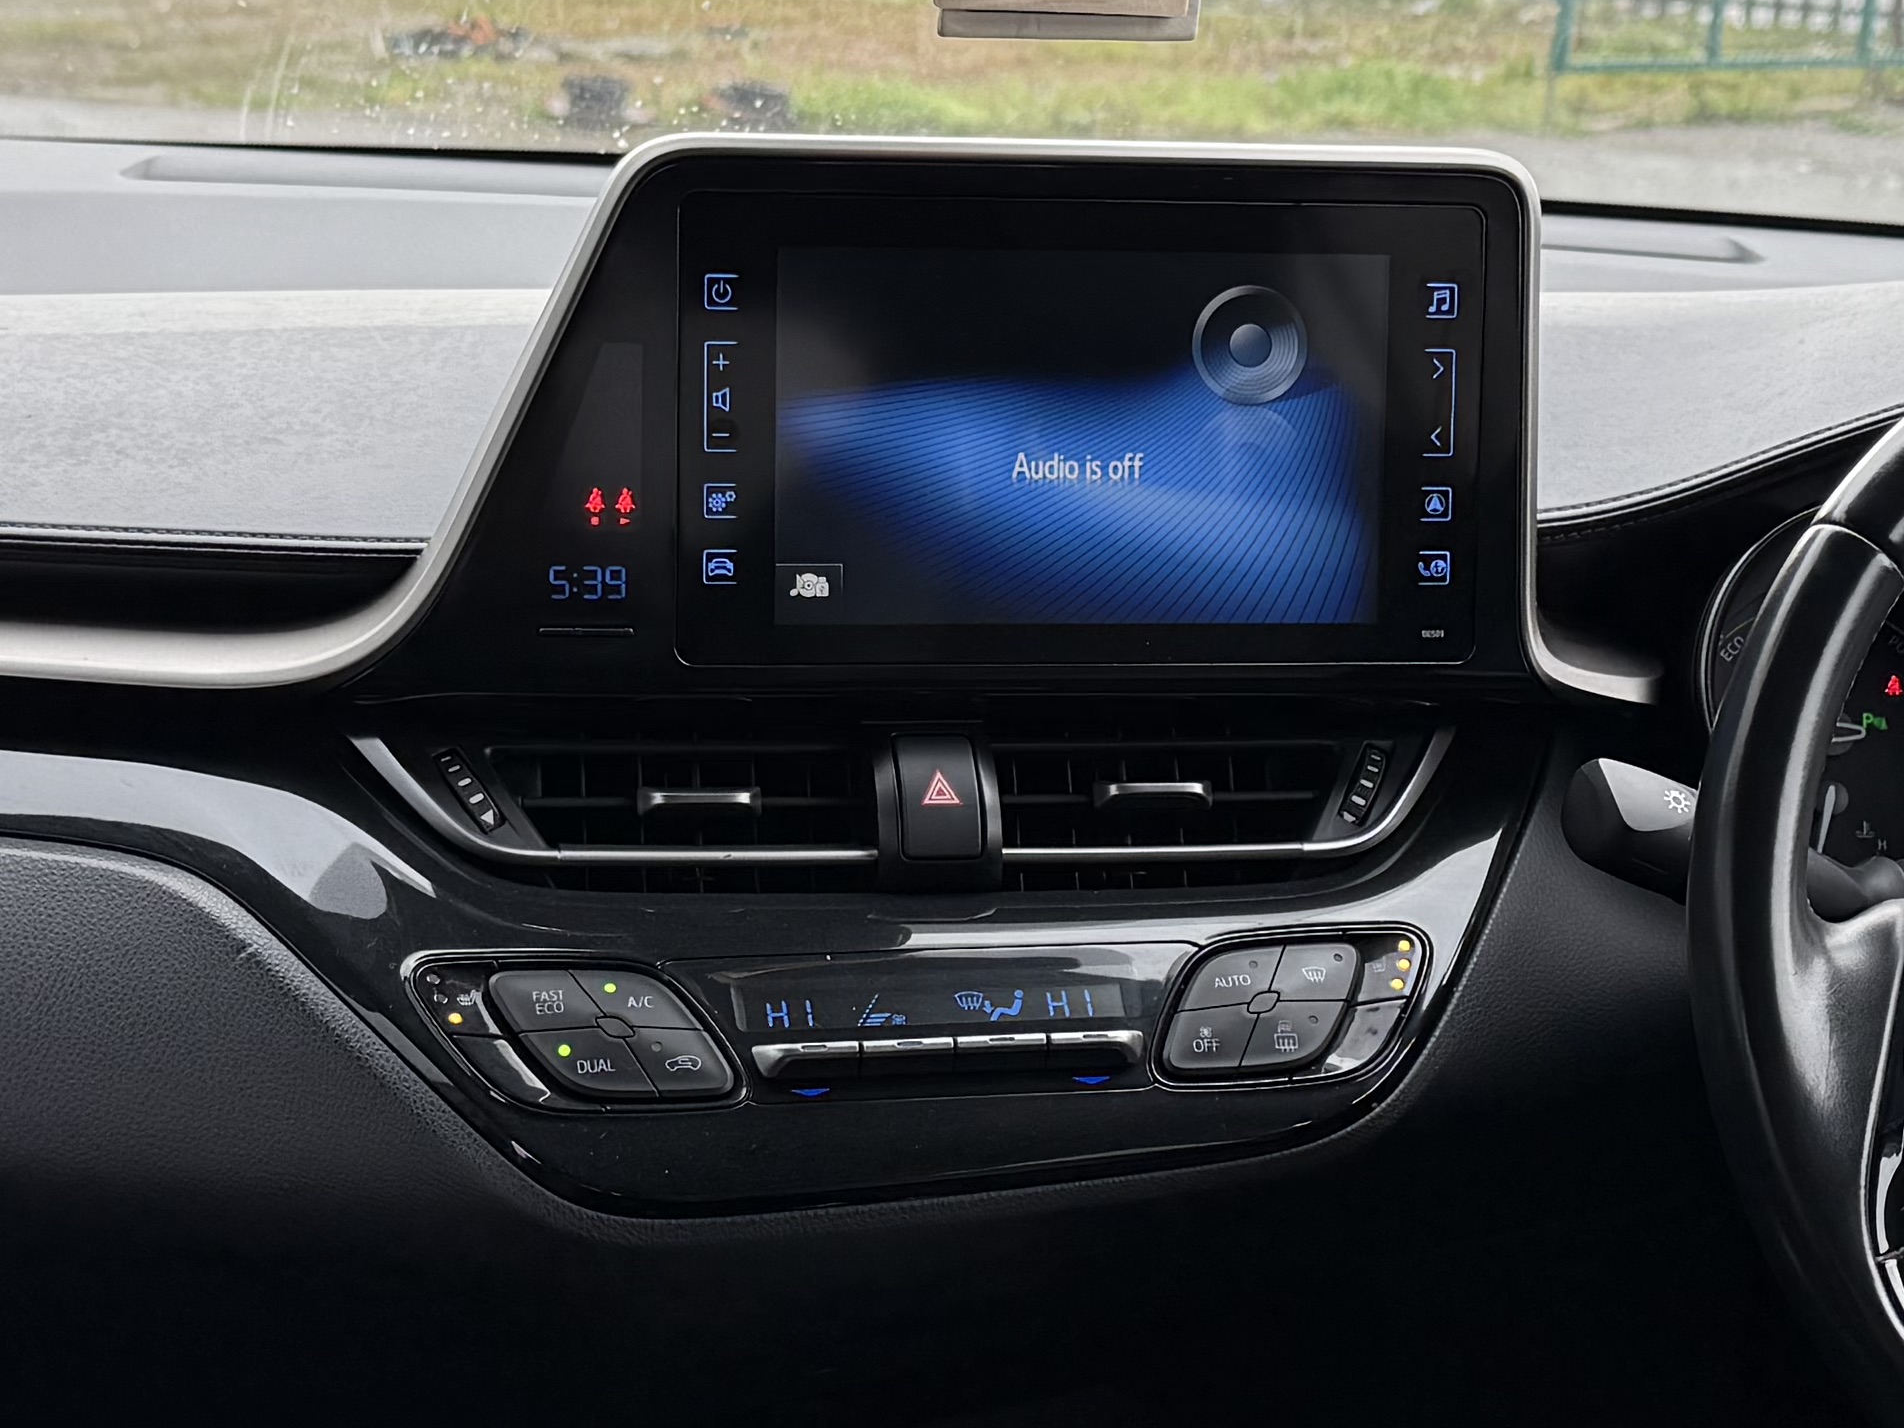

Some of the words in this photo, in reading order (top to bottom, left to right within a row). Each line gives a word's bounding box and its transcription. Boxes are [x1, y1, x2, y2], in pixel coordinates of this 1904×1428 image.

[1011, 451, 1080, 480] Audio
[1085, 454, 1102, 480] is
[1108, 452, 1144, 480] off
[548, 565, 627, 600] 5:39
[1213, 974, 1251, 989] AUTO
[532, 989, 564, 1002] FAST
[627, 995, 654, 1009] A/C
[535, 1002, 564, 1015] ECO
[1045, 989, 1094, 1018] HI
[765, 999, 814, 1028] HI
[1192, 1039, 1220, 1053] OFF
[576, 1059, 616, 1074] DUAL
